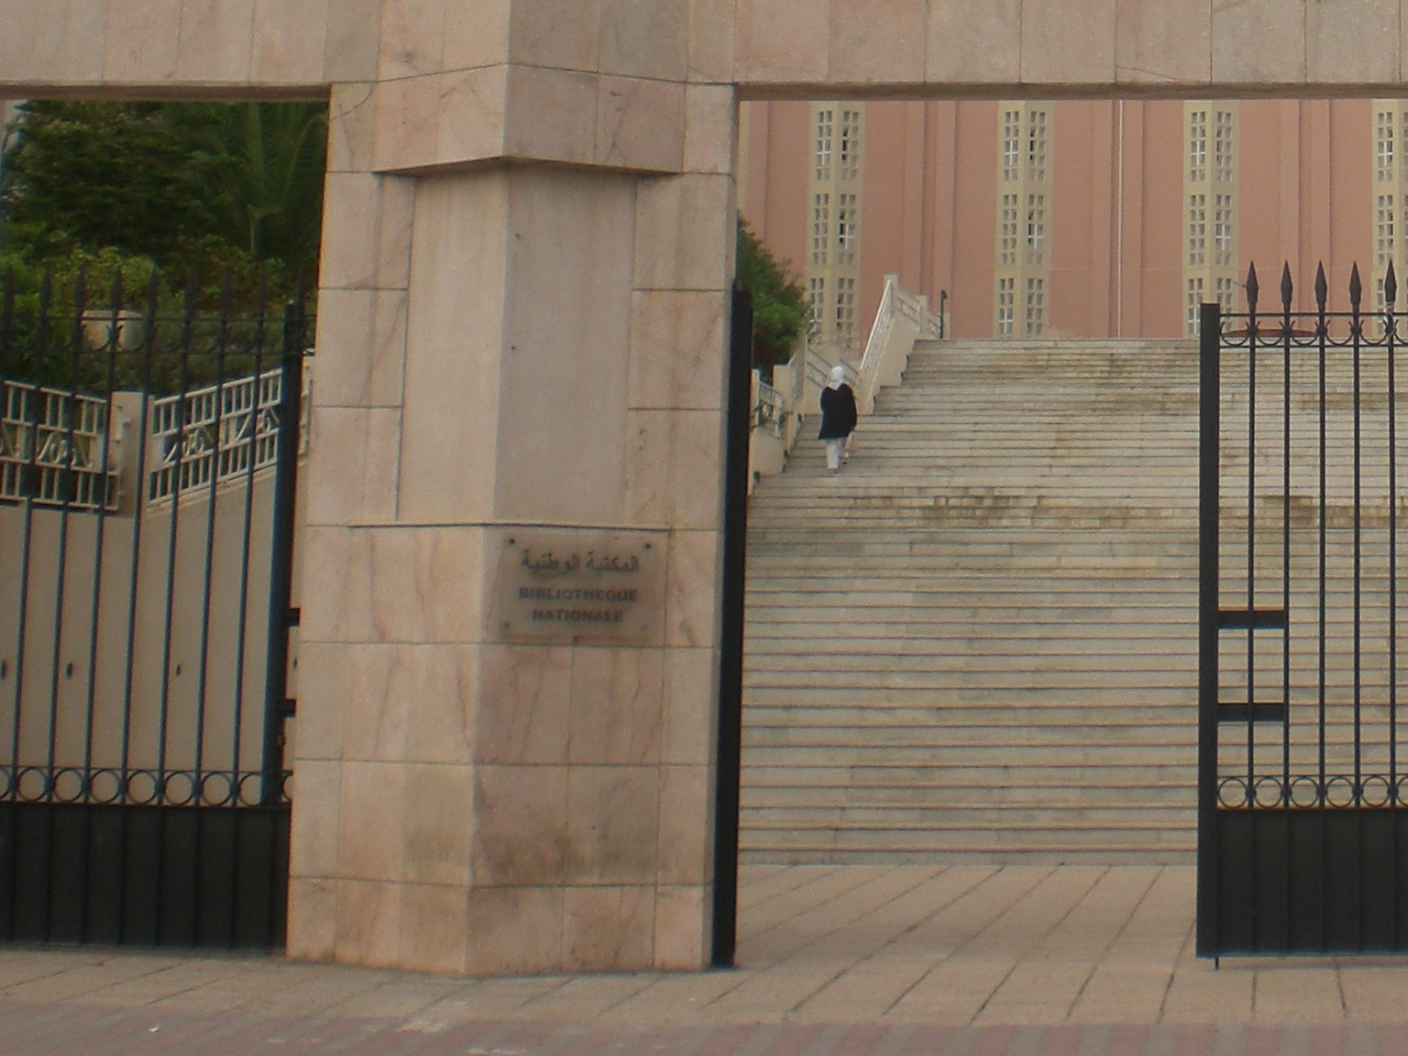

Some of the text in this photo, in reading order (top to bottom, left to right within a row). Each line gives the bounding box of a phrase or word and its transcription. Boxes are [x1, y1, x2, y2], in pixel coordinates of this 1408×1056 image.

[521, 549, 639, 576] المكتبة الوطنية
[518, 587, 636, 602] BIBLIOTHEQUE
[532, 610, 623, 622] NATIONALE
